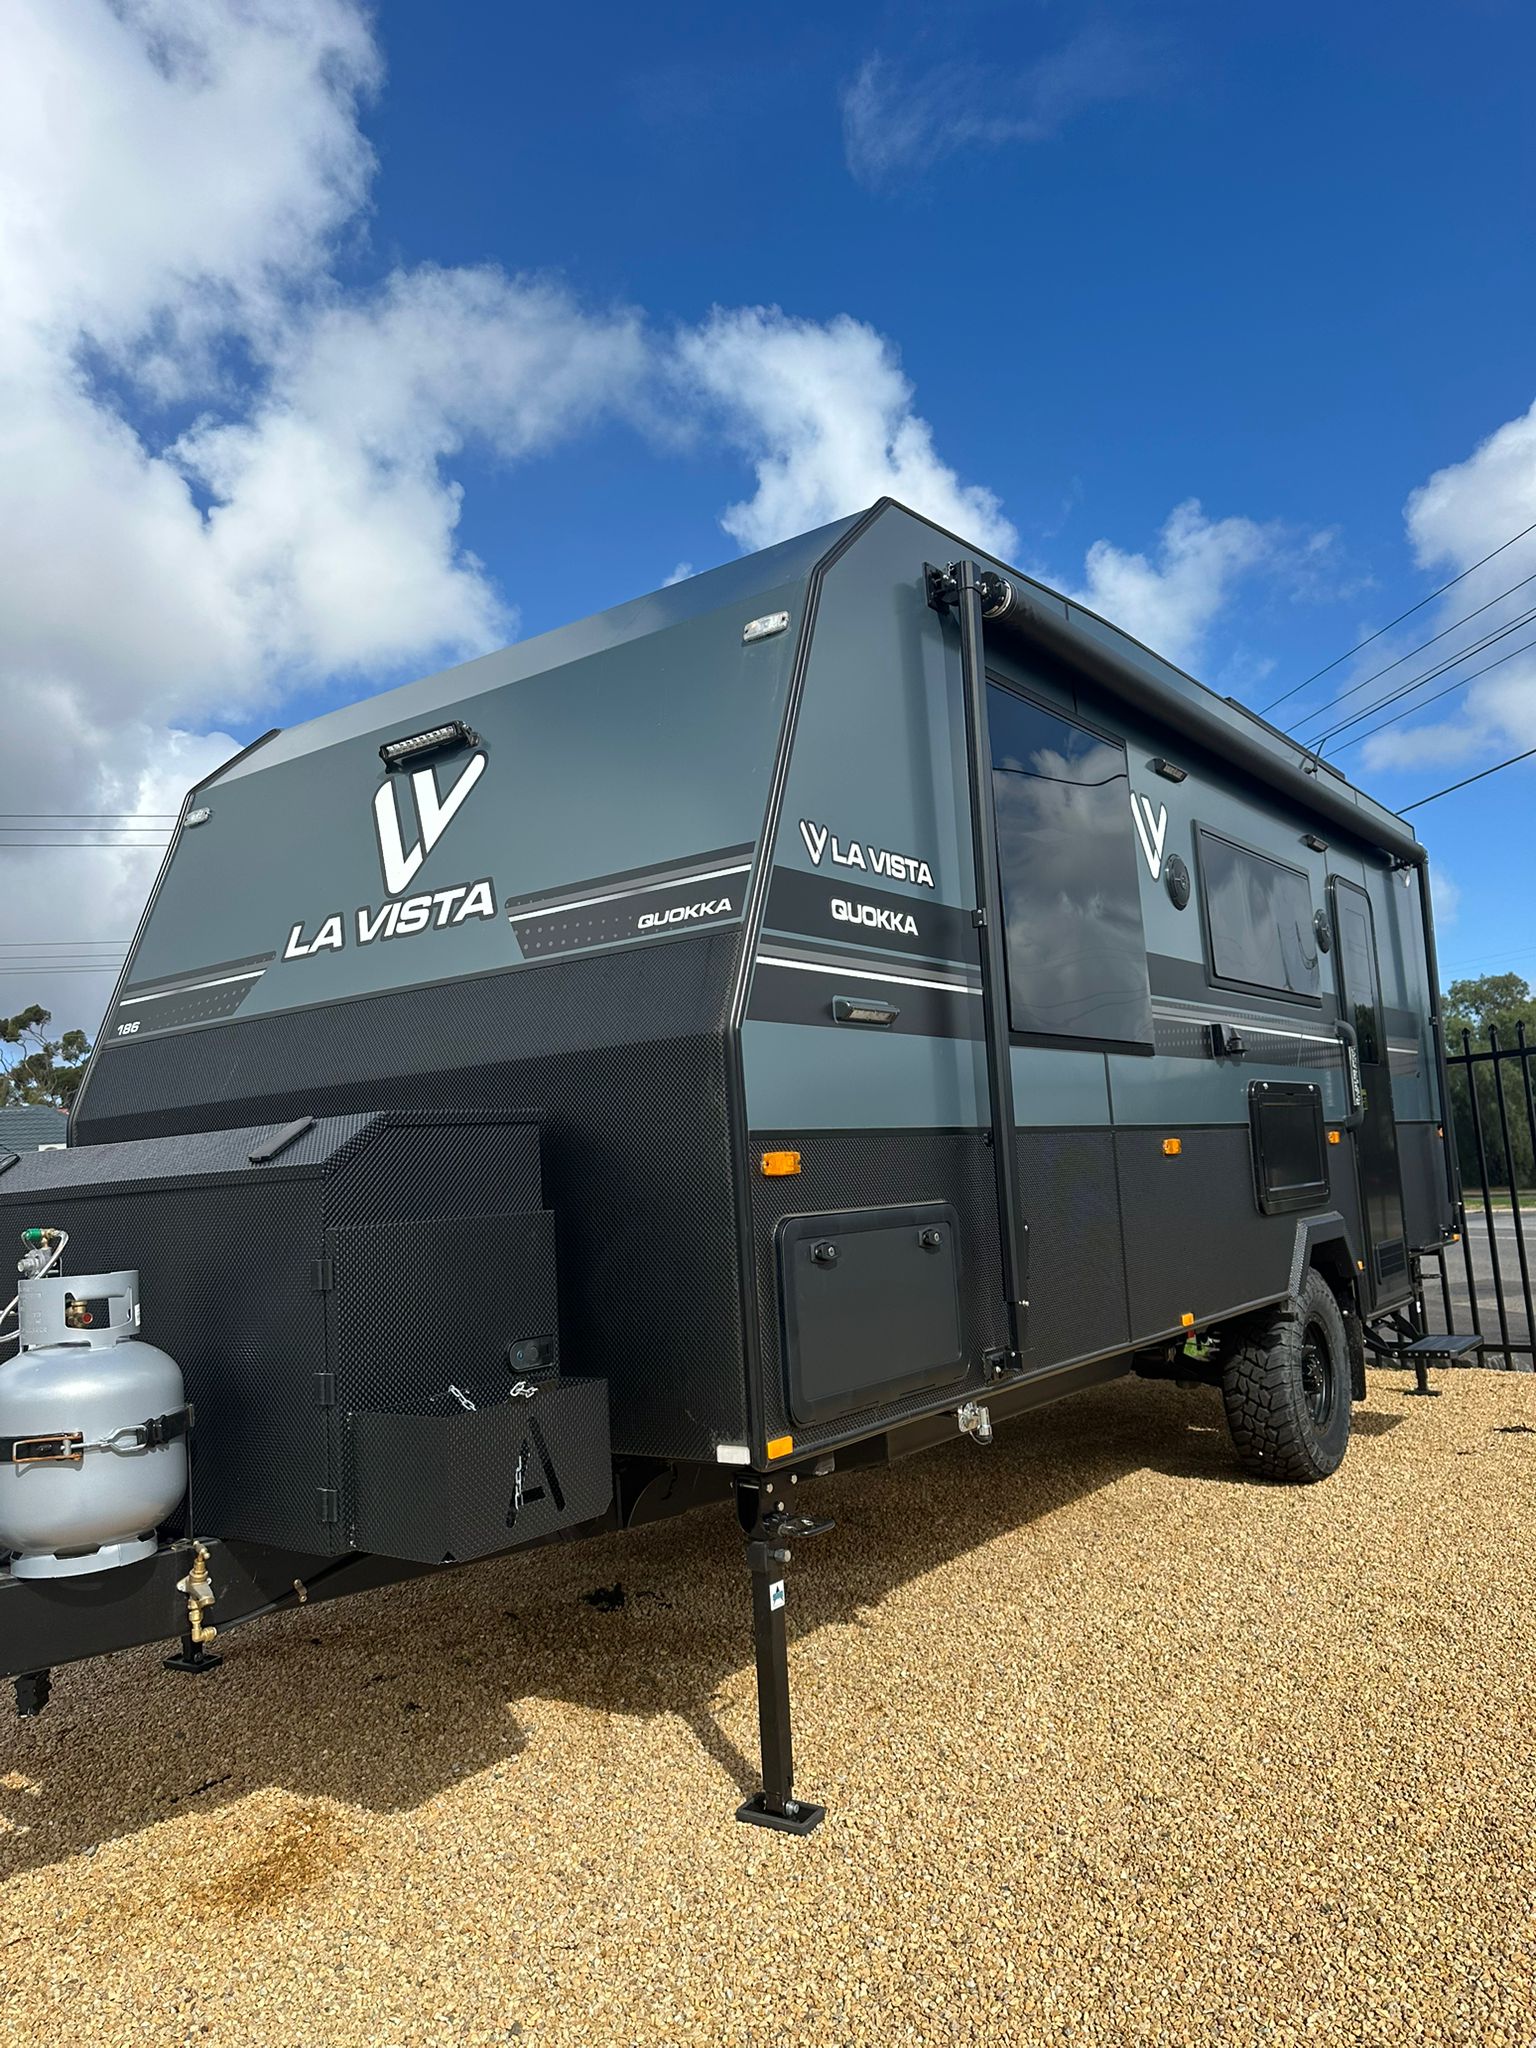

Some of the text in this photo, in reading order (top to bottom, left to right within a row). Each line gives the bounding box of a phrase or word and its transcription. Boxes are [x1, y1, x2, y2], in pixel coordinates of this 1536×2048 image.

[831, 837, 867, 869] LA
[867, 847, 934, 887] VISTA
[284, 881, 494, 959] LA VISTA
[638, 898, 732, 929] QUOKKA
[831, 898, 919, 936] QUOKKA
[117, 1021, 141, 1036] 186
